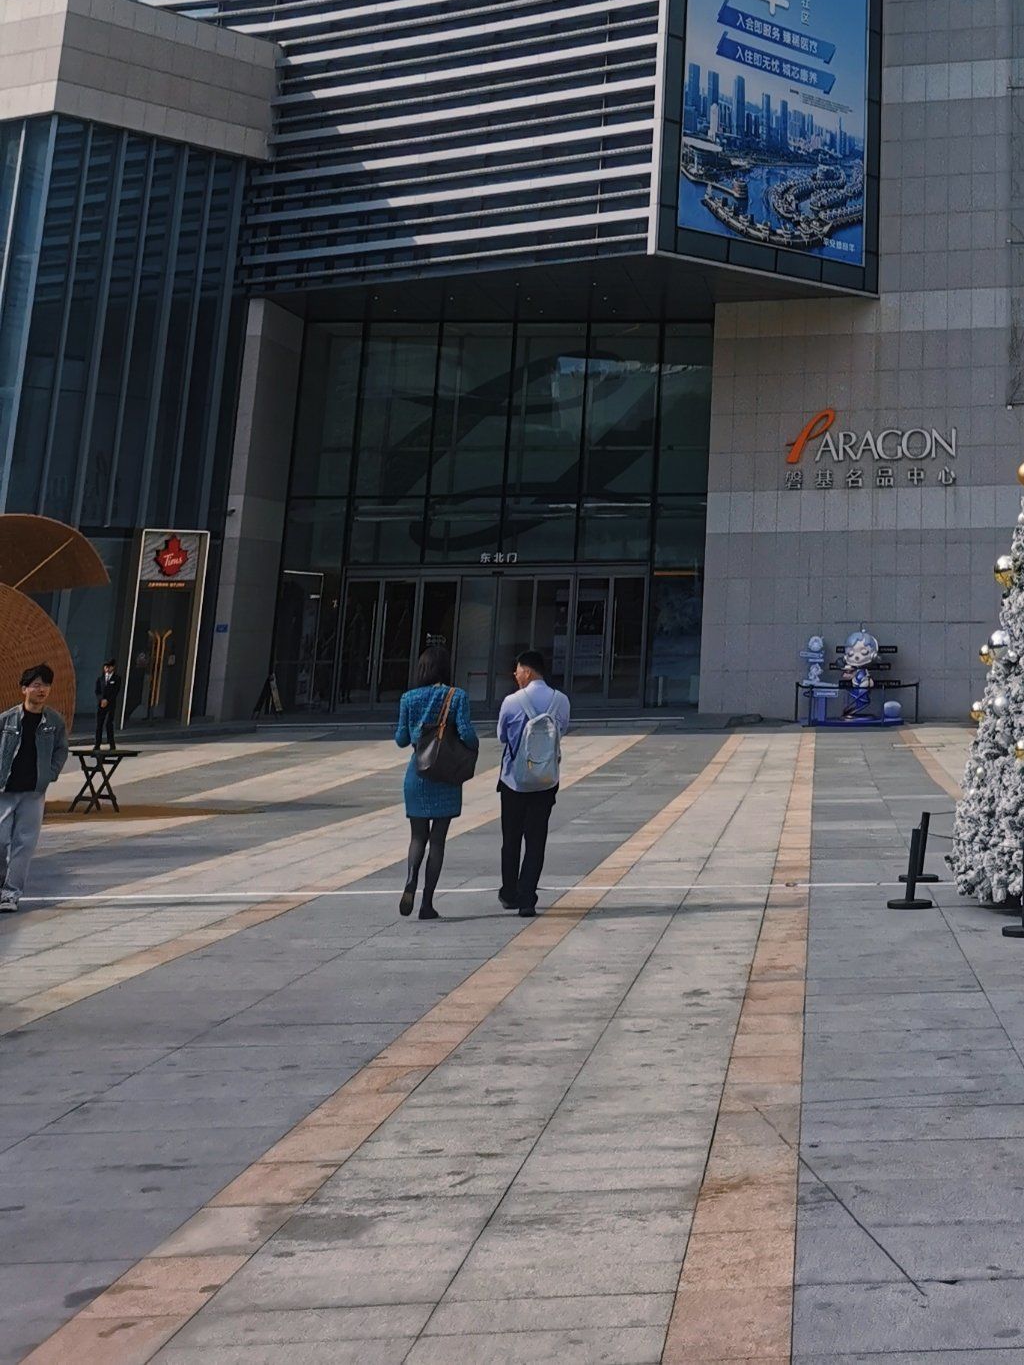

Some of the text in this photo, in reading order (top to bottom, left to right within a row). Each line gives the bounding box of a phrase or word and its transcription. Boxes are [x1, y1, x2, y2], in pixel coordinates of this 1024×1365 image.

[736, 13, 781, 42] 入会即服务
[735, 45, 780, 74] 入住即无忧
[785, 466, 957, 489] 磐基名品中心
[163, 553, 184, 567] Tims
[480, 552, 518, 564] 东北门
